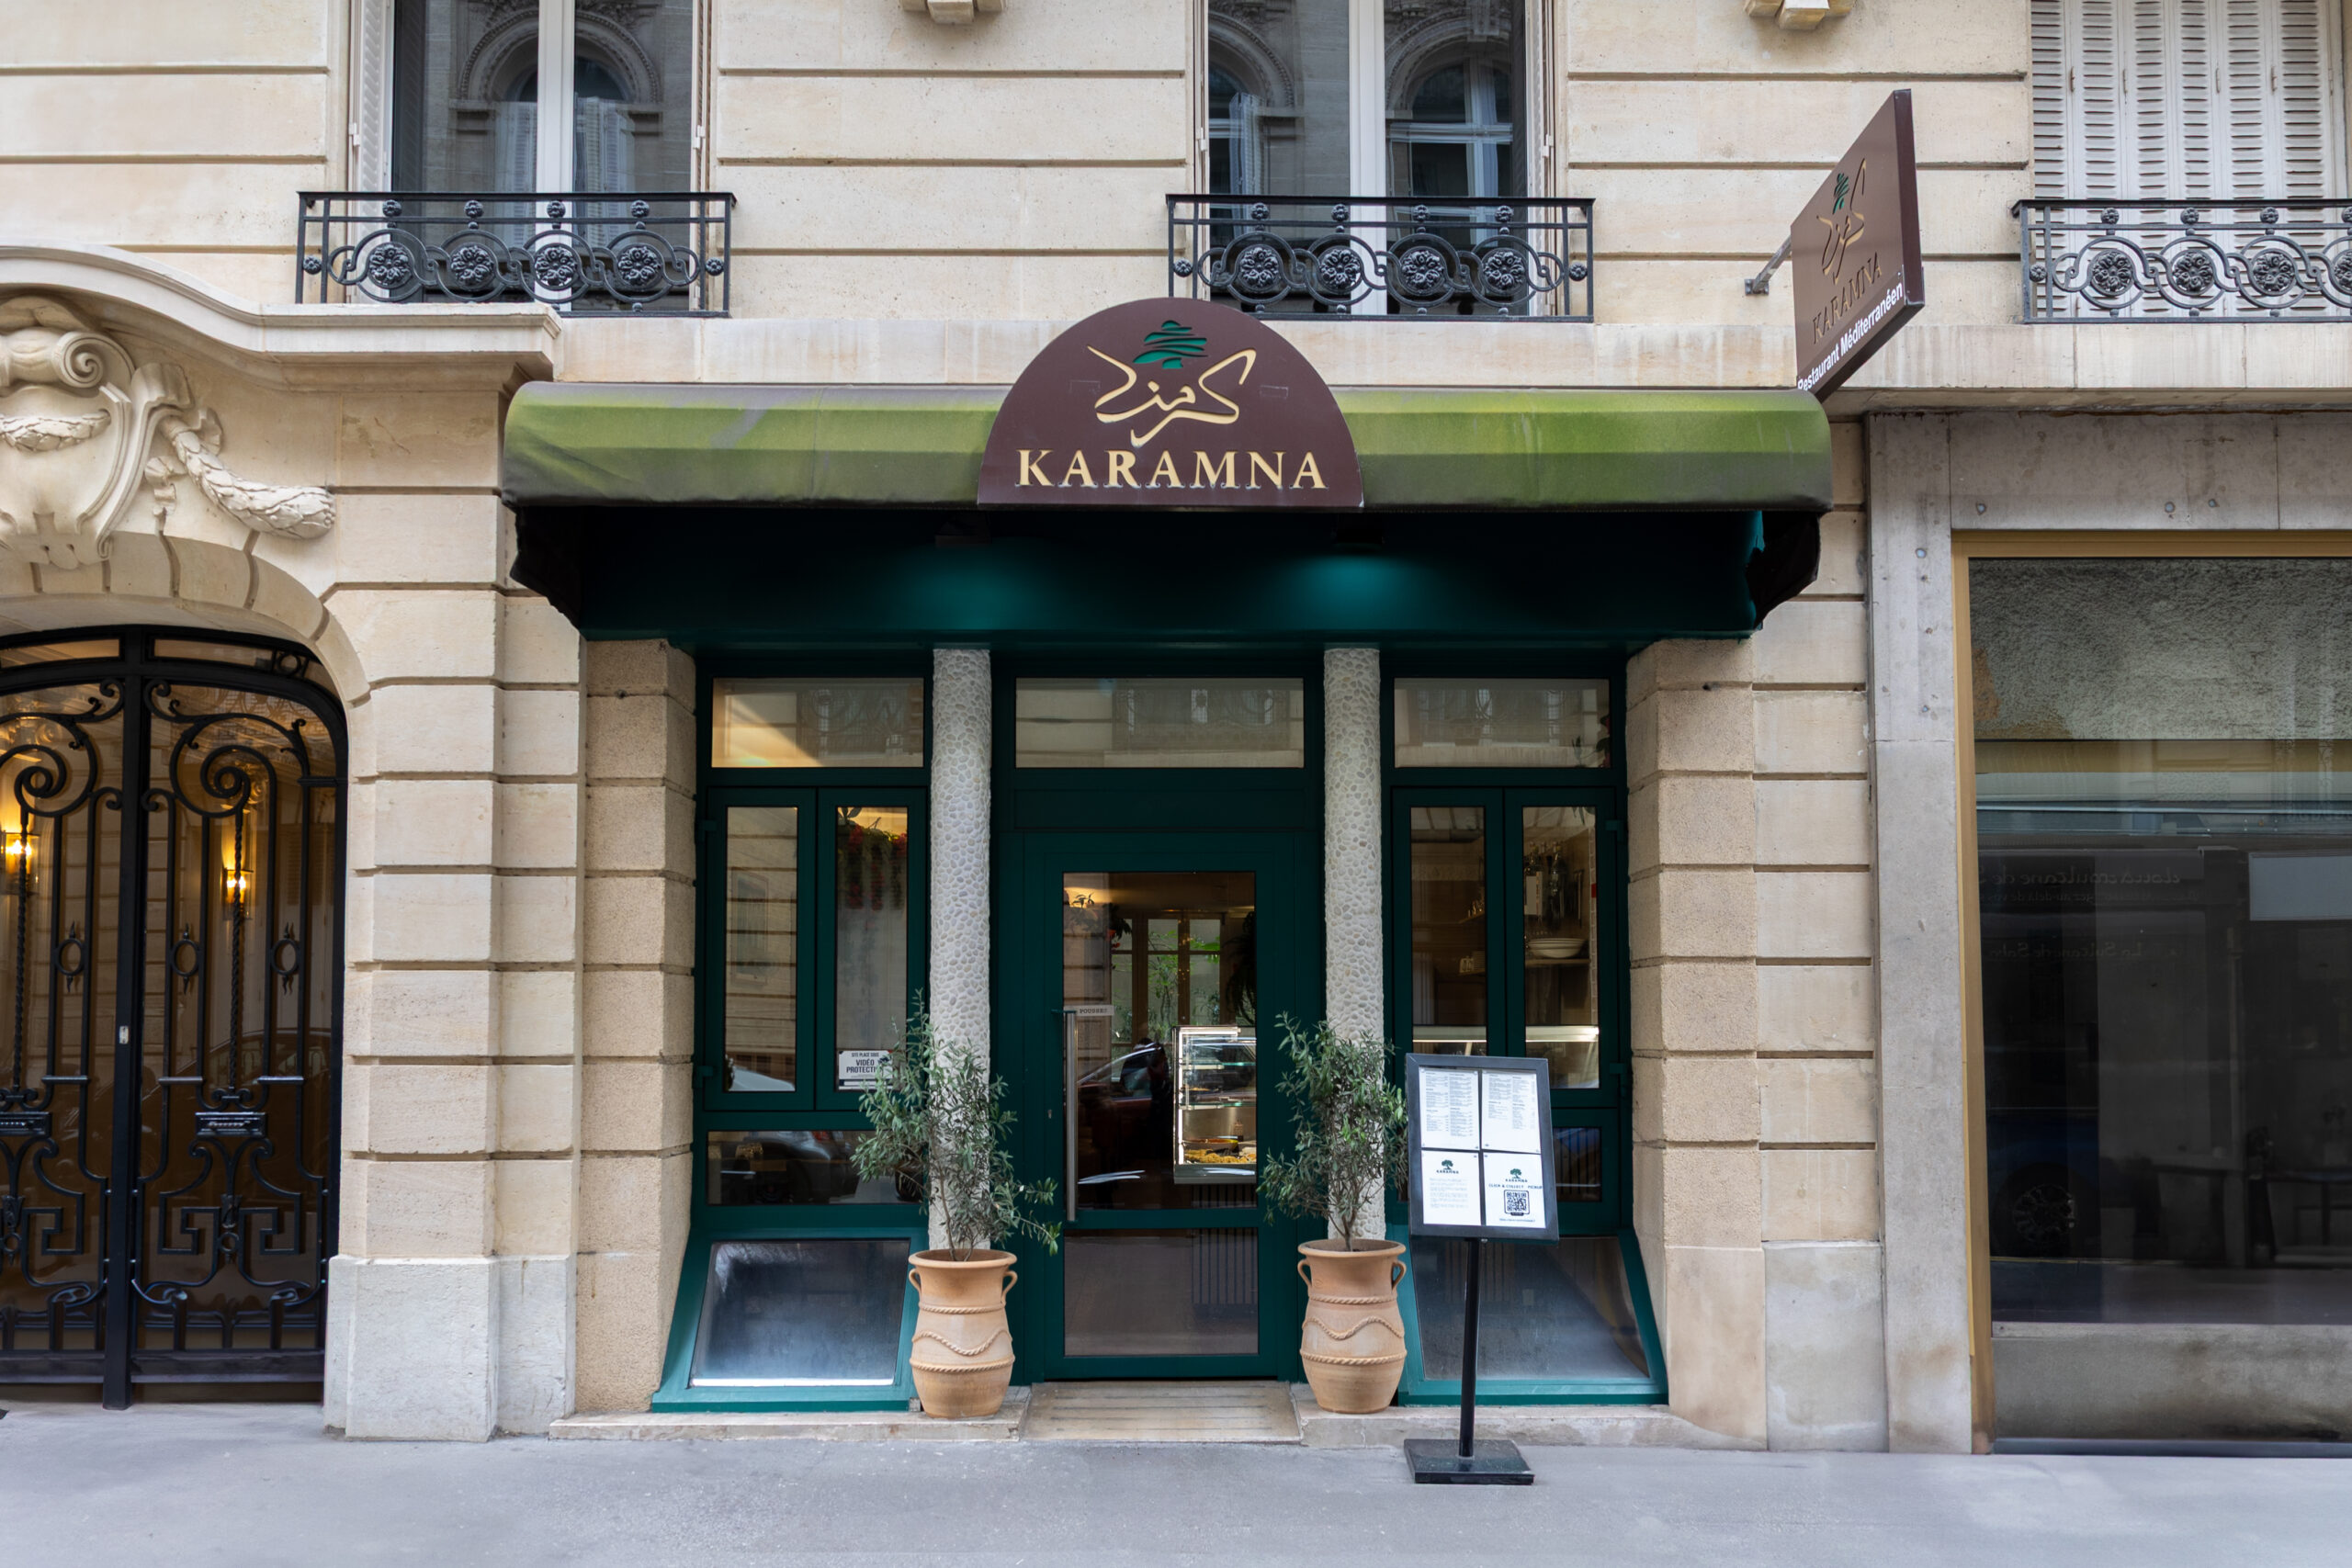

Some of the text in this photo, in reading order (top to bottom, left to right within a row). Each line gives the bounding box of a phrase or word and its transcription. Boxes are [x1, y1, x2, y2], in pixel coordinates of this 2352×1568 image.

[1812, 251, 1883, 344] KARAMNA
[1797, 282, 1904, 391] Restaurant Méditerranéen
[1014, 448, 1329, 490] KARAMNA
[846, 1066, 880, 1074] PROTECTI
